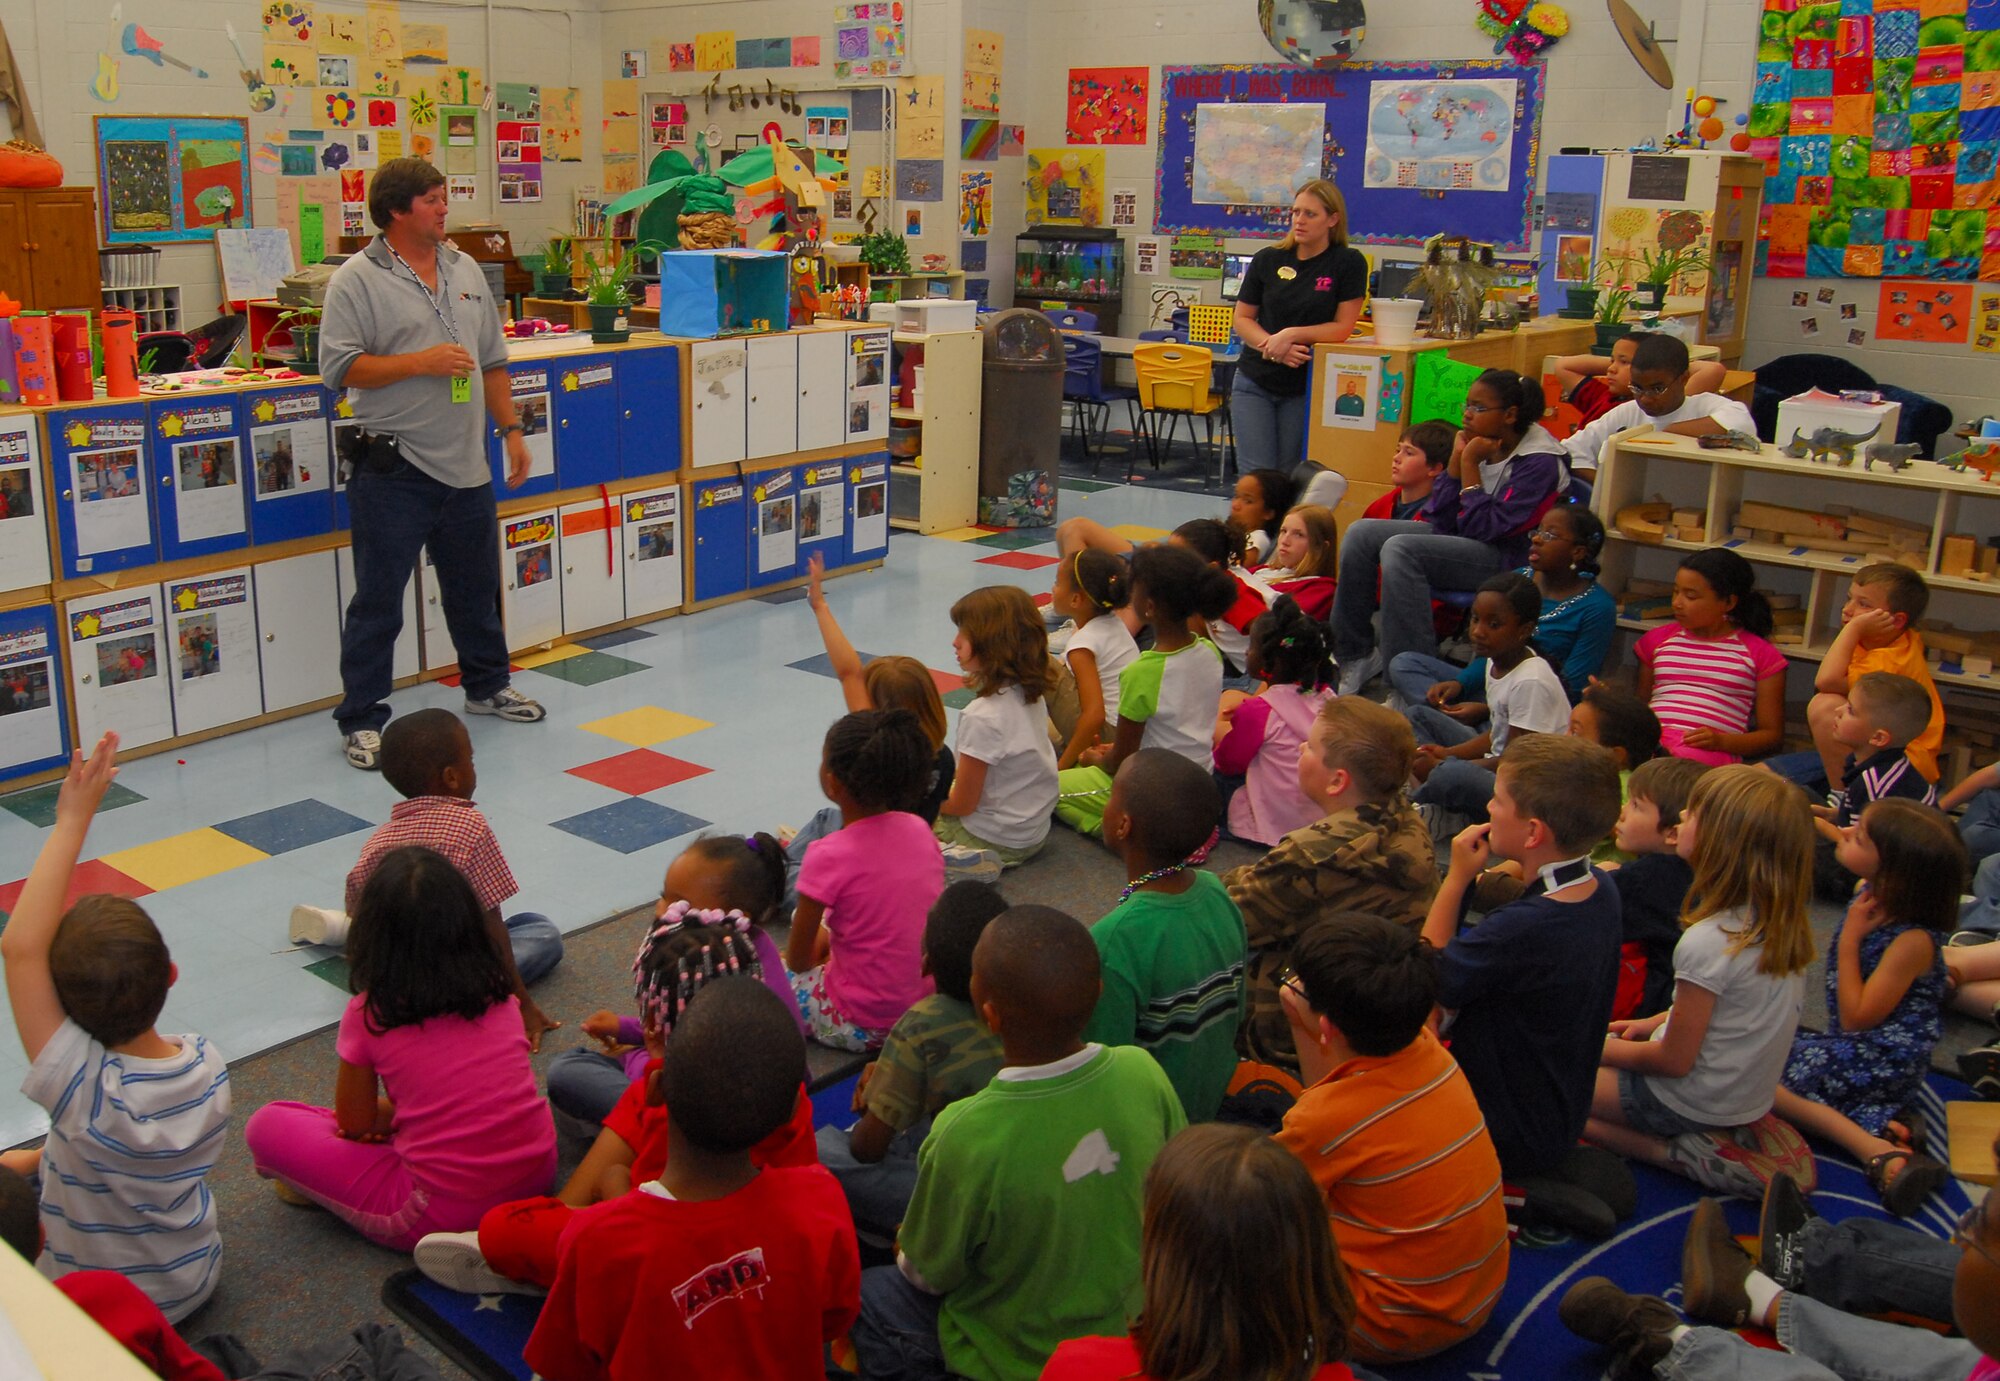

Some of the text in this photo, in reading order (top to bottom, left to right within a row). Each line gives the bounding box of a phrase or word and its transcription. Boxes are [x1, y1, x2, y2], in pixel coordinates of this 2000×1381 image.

[1174, 75, 1223, 98] WHERE
[1230, 75, 1236, 98] I
[1250, 75, 1282, 98] WAS
